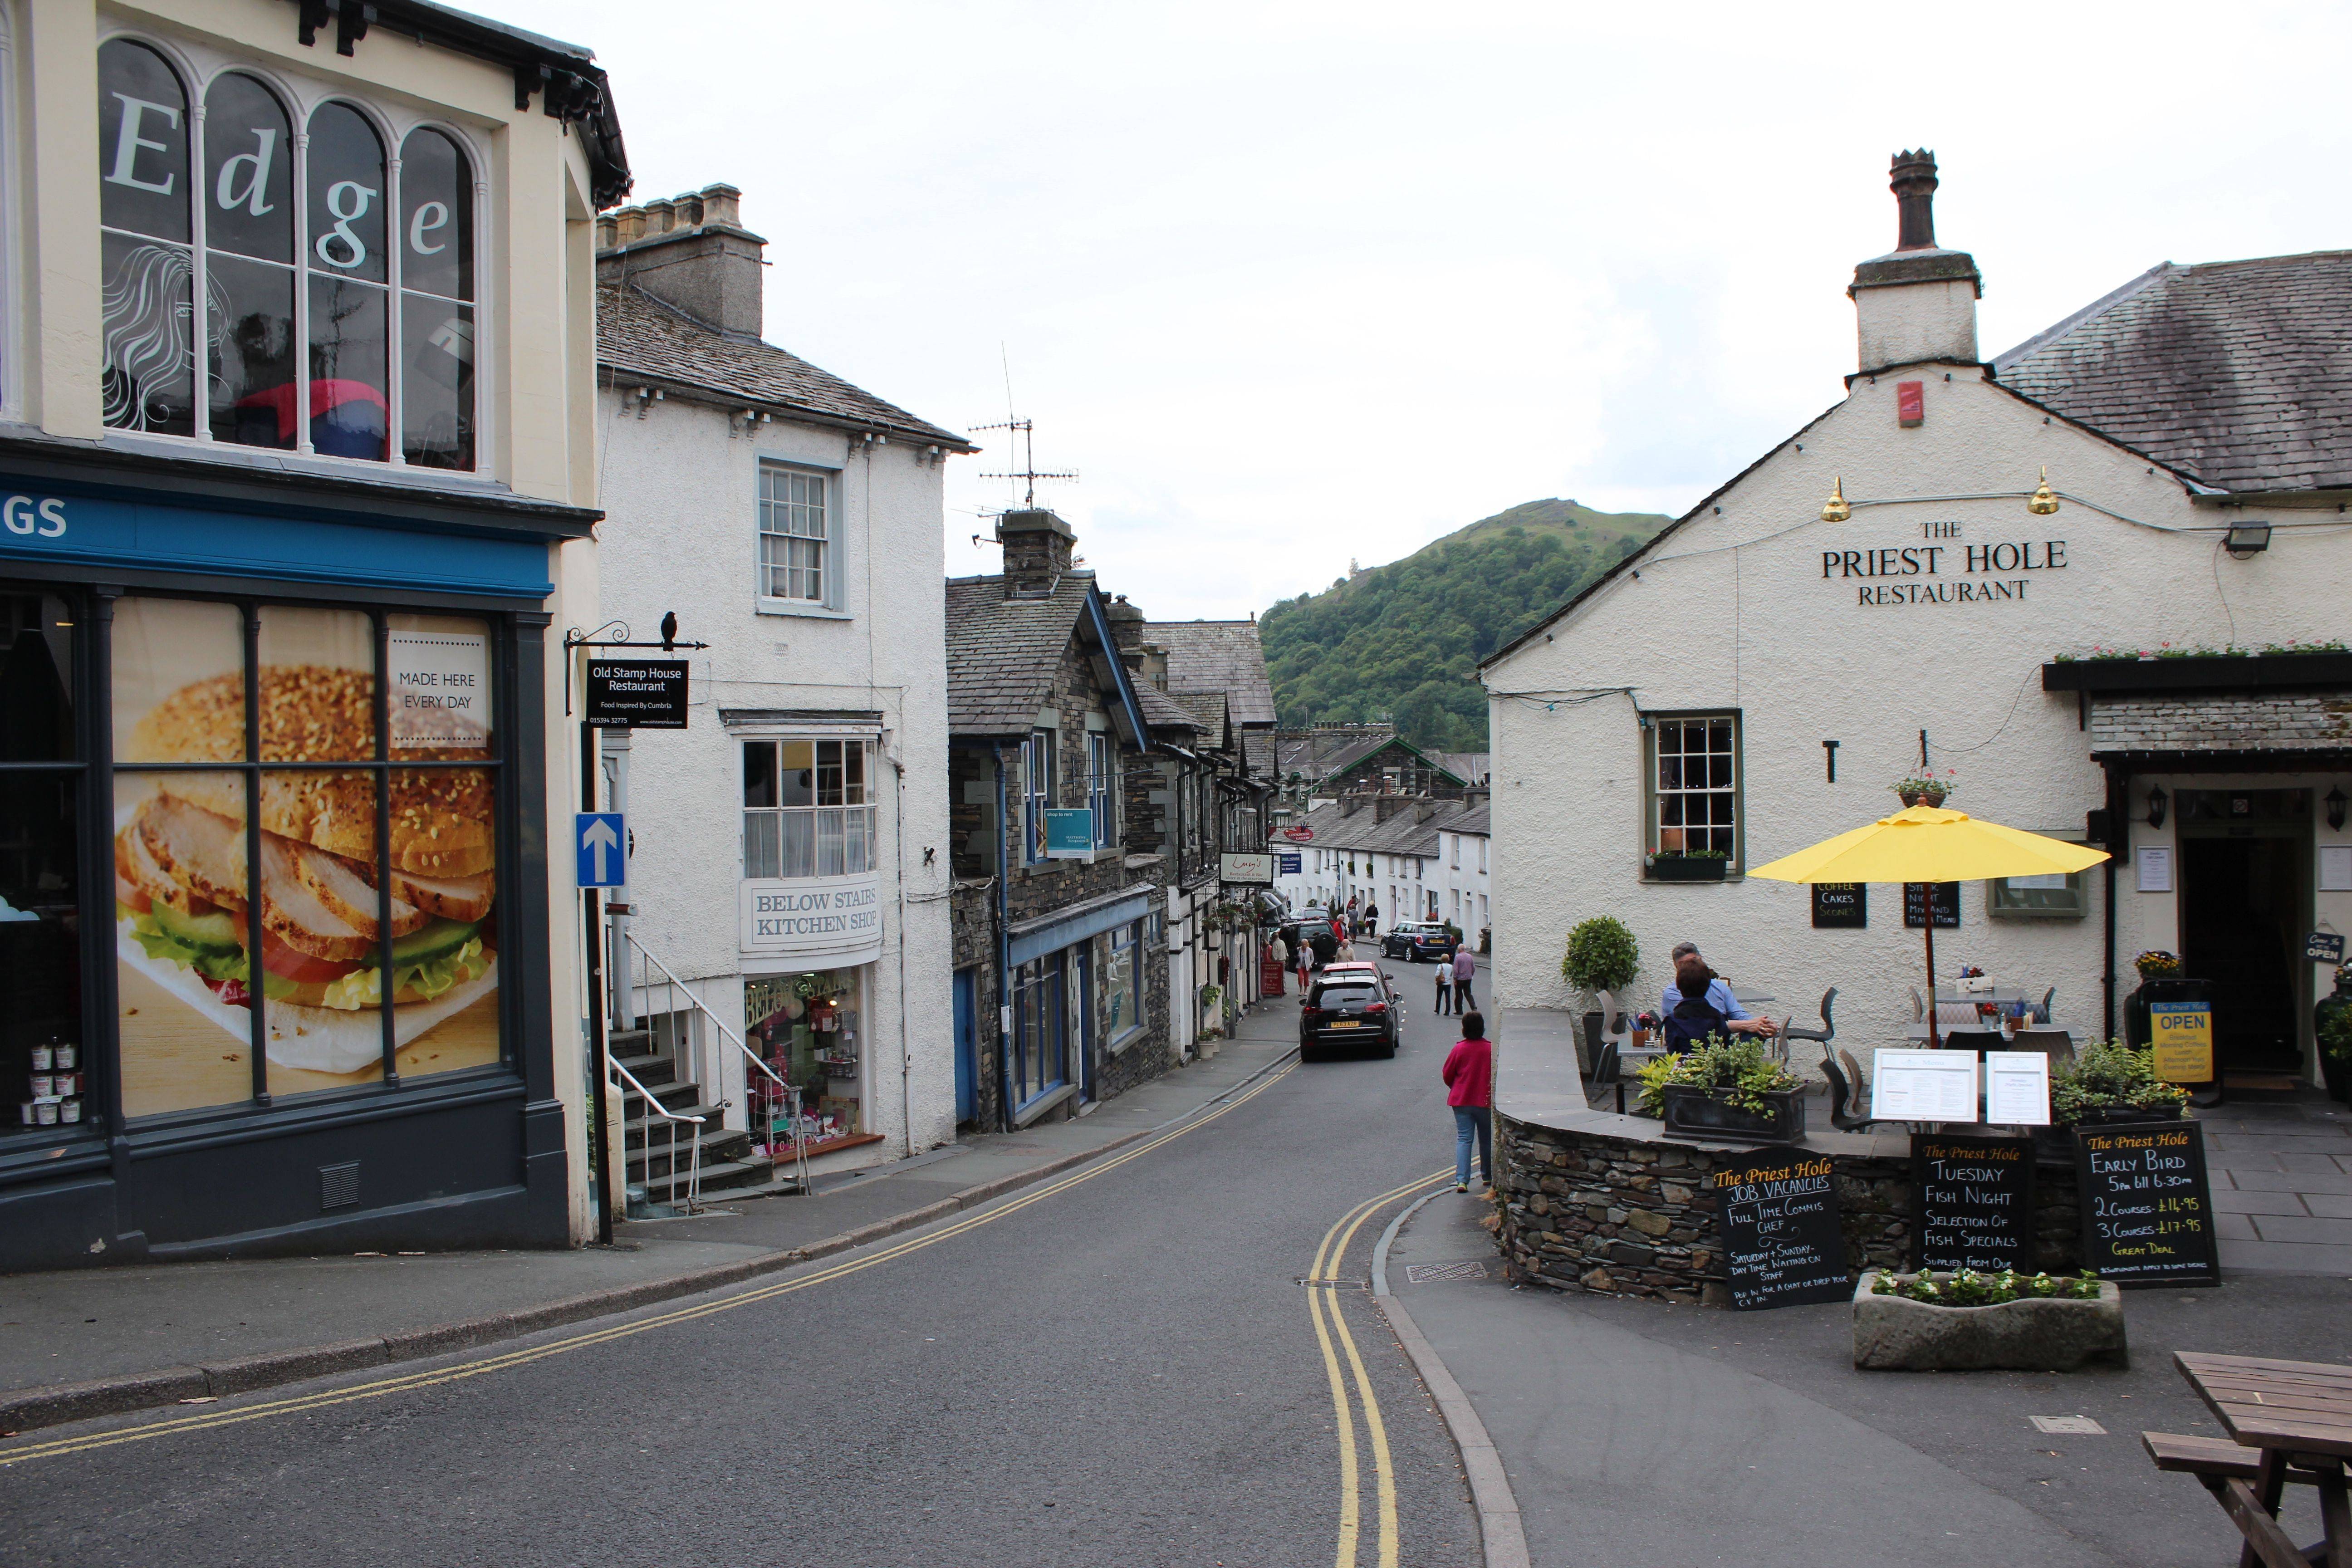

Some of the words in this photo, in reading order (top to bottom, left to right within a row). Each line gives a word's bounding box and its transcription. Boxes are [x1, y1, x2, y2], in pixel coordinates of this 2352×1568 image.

[104, 92, 448, 269] Edge
[3, 495, 67, 537] GS
[1921, 521, 1962, 538] THE
[1822, 547, 1944, 578] PRIEST
[1966, 541, 2068, 572] HOLE
[1860, 580, 2029, 605] RESTAURANT
[400, 672, 437, 685] MADE
[444, 674, 475, 686] HERE
[593, 667, 611, 677] Old
[613, 668, 646, 681] Stamp
[649, 668, 681, 678] House
[609, 680, 665, 691] Restaurant
[405, 696, 443, 708] EVERY
[448, 696, 471, 708] DAY
[1232, 856, 1261, 873] Lucy's
[1908, 883, 1939, 891] STEK
[757, 893, 831, 912] BELOW
[835, 888, 876, 908] STAIRS
[1822, 892, 1854, 903] CAKES
[1819, 905, 1856, 916] SCONES
[1936, 915, 1956, 923] MENU
[757, 915, 847, 935] KITCHEN
[851, 910, 877, 930] SHOP
[2307, 948, 2338, 960] OPEN
[2161, 1015, 2205, 1030] OPEN
[2087, 1136, 2112, 1150] The
[2115, 1135, 2153, 1148] Priest
[2156, 1132, 2188, 1147] Hole
[1923, 1145, 1945, 1157] The
[1950, 1147, 1986, 1158] Priest
[1989, 1147, 2020, 1161] Hole
[2091, 1153, 2137, 1173] EARLY
[2145, 1149, 2186, 1170] BIRD
[1714, 1169, 1741, 1187] The
[1746, 1166, 1791, 1183] Priest
[1795, 1158, 1832, 1178] Hole
[1931, 1160, 2004, 1181] TUESDAY
[1727, 1185, 1759, 1202] JOB
[1764, 1176, 1829, 1198] VACANCIES
[2135, 1176, 2149, 1188] till
[1926, 1186, 1956, 1203] FISH
[1966, 1186, 2013, 1205] NIGHT
[1728, 1207, 1754, 1226] FULL
[1753, 1202, 1783, 1220] TIME
[1785, 1198, 1824, 1215] COMMIS
[2095, 1197, 2109, 1216] 2
[2159, 1198, 2199, 1212] £14.95
[1757, 1220, 1784, 1234] CHEF
[1926, 1210, 1988, 1226] SELECTION
[1992, 1215, 2008, 1227] OF
[2097, 1223, 2111, 1238] 3
[2159, 1219, 2200, 1234] £17.95
[1925, 1230, 1954, 1245] FISH
[1961, 1230, 2017, 1247] SPECIALS
[2112, 1242, 2146, 1255] GREAT
[2146, 1242, 2176, 1254] DEAL
[1729, 1267, 1747, 1275] DAY
[1747, 1263, 1768, 1273] TIME
[1772, 1257, 1807, 1269] WAITING
[1808, 1255, 1821, 1264] ON
[1730, 1251, 1769, 1264] SATURDAY
[1924, 1253, 1962, 1267] SUPPLIED
[1967, 1256, 1989, 1267] FROM
[1993, 1258, 2011, 1269] OUR
[1760, 1271, 1784, 1281] STAFF
[1784, 1282, 1801, 1291] CHAT
[1814, 1277, 1830, 1285] DROP
